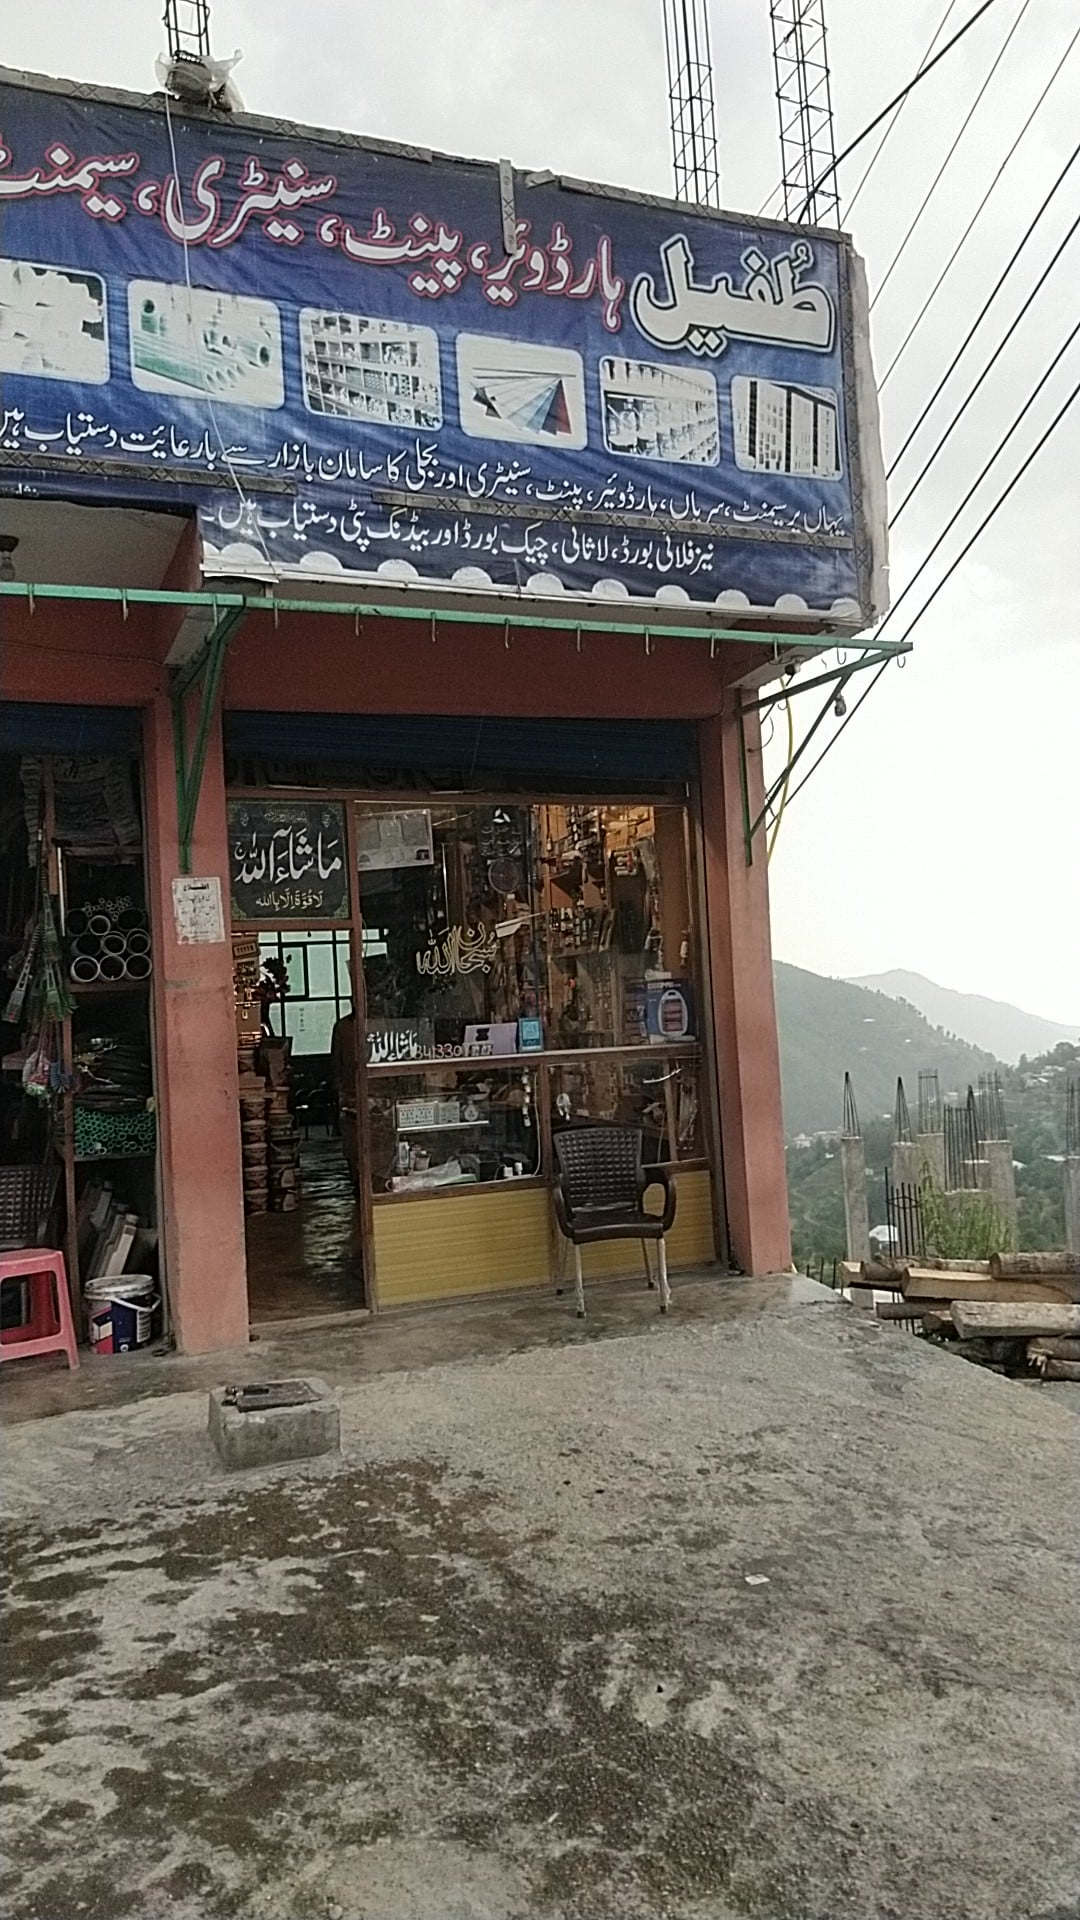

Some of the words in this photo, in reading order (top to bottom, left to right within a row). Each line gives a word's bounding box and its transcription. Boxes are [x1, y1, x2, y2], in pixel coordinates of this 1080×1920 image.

[24, 411, 117, 456] دستیاب
[220, 443, 266, 464] سے
[268, 441, 315, 482] بازار
[318, 448, 383, 480] سامان
[386, 450, 407, 482] کا
[405, 438, 438, 491] بجلی
[434, 464, 463, 489] اور
[256, 500, 338, 540] دستیاب
[340, 497, 370, 552] پٹی
[430, 520, 459, 546] اور
[461, 517, 499, 555] بورڈ
[803, 506, 846, 536] یہاں
[689, 542, 714, 575] نیز
